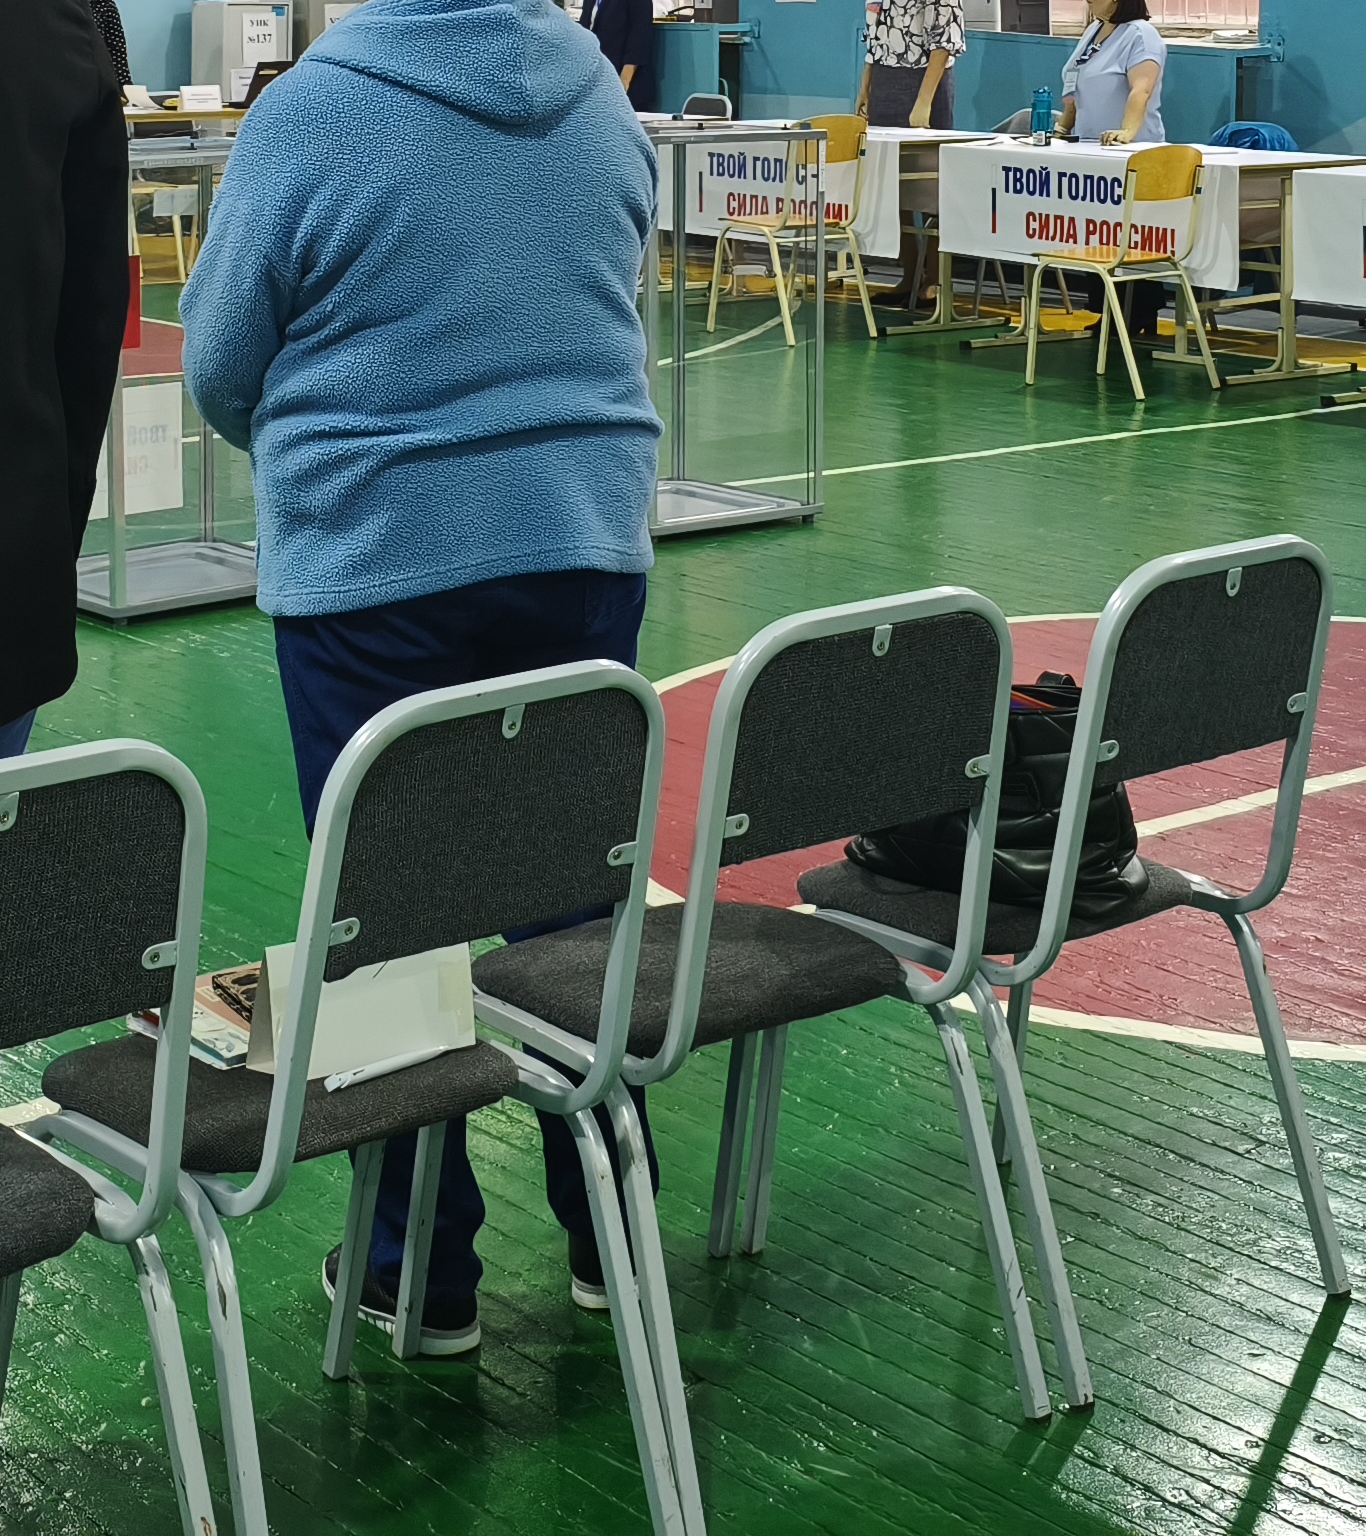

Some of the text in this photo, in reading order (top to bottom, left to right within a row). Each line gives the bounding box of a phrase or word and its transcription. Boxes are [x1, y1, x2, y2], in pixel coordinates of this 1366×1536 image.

[707, 151, 748, 181] ТВОЙ
[1001, 165, 1123, 206] ТВОЙ ГОЛОС
[726, 191, 770, 218] СИЛА
[1025, 211, 1078, 245] СИЛА
